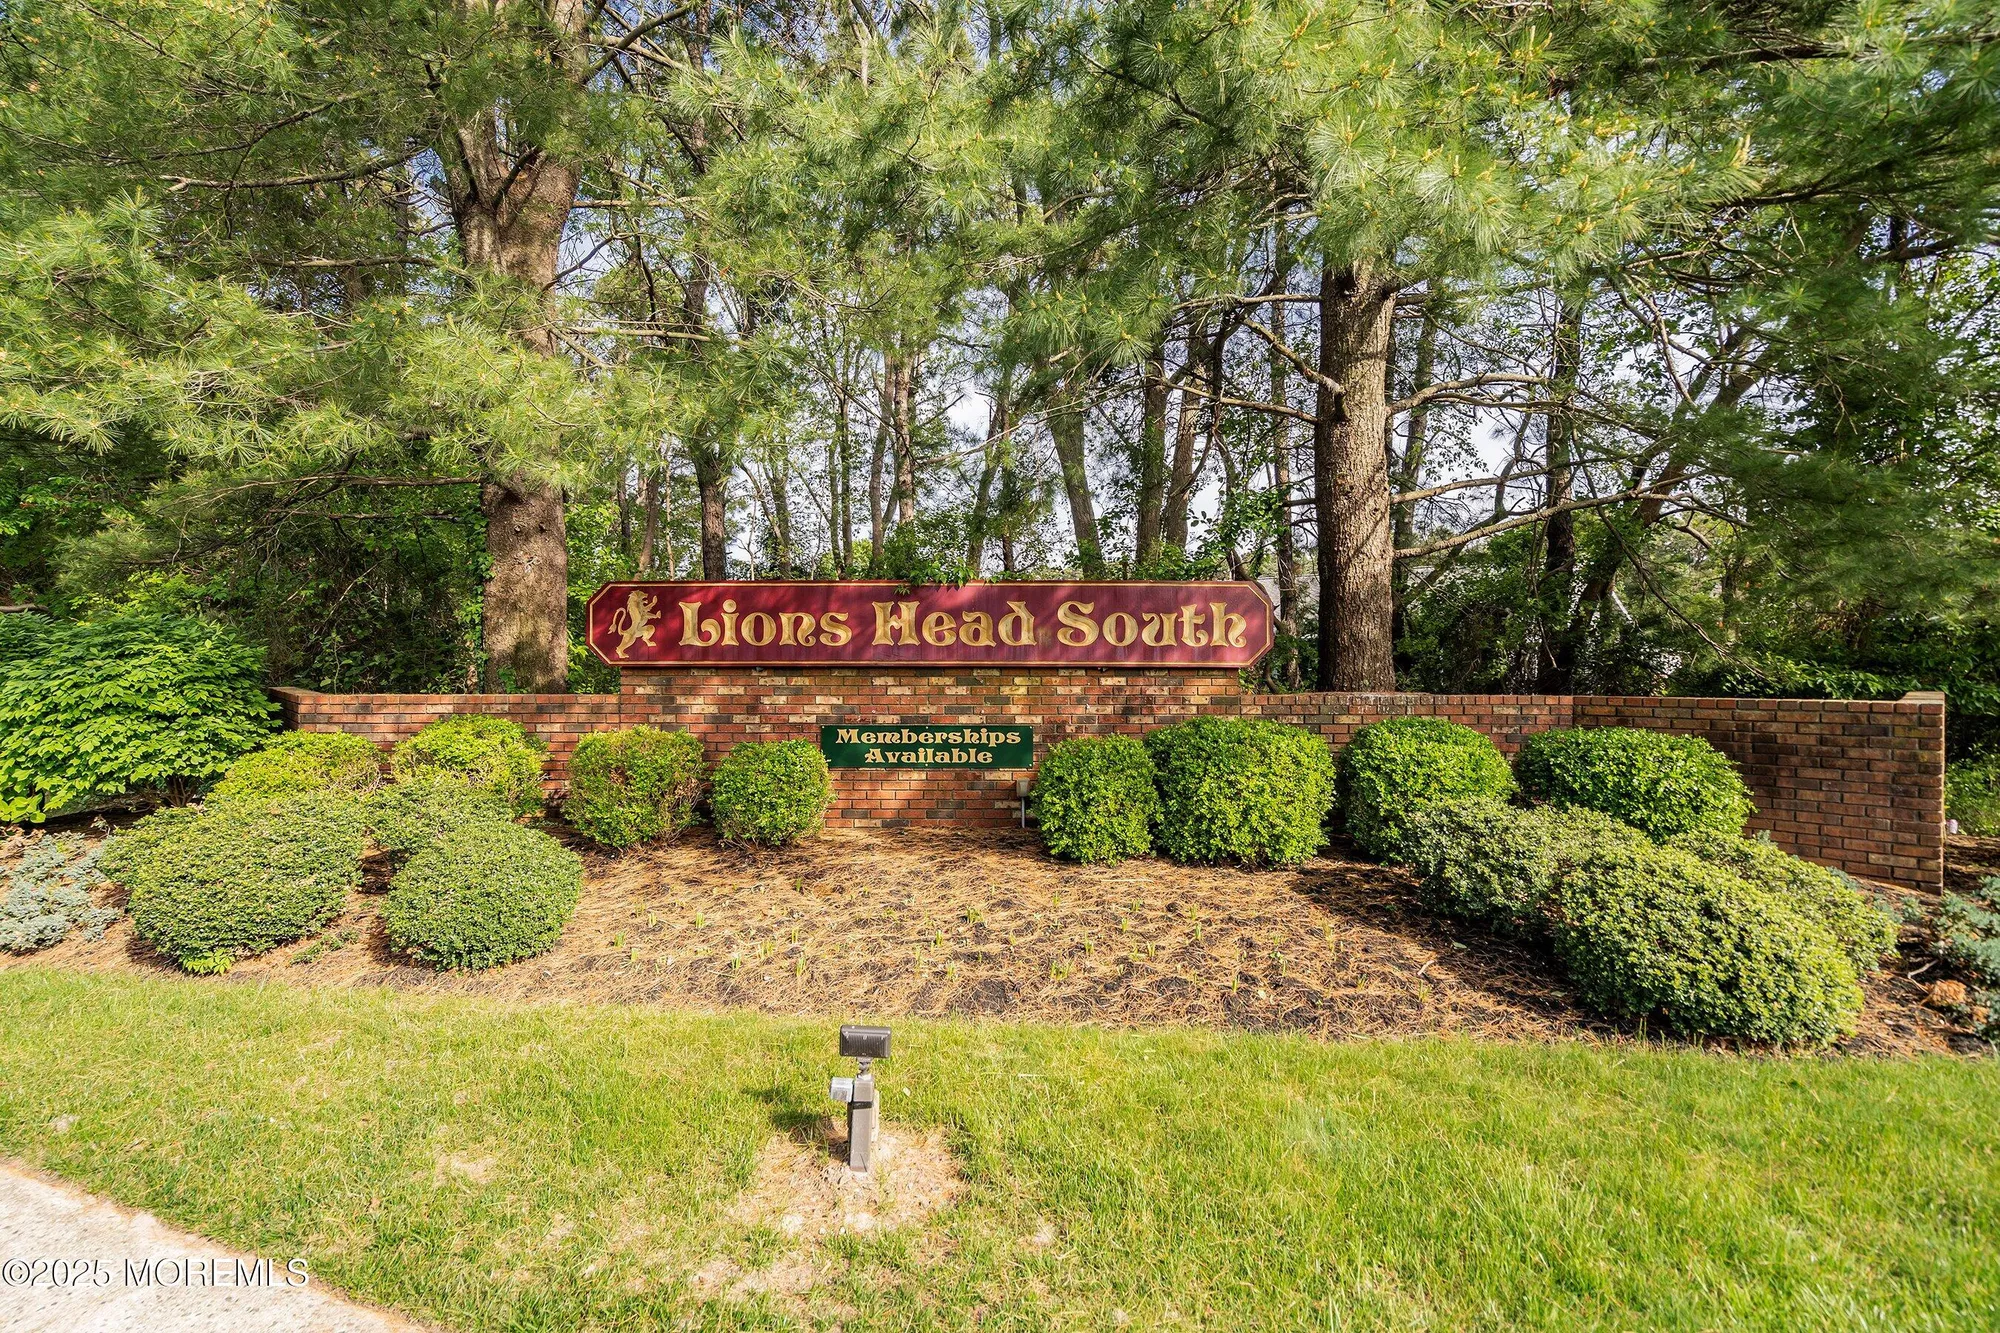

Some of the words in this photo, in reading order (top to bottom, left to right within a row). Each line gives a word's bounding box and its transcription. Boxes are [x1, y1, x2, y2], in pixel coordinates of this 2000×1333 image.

[678, 598, 852, 647] Lions
[871, 600, 1037, 647] Head
[1057, 600, 1247, 647] South
[835, 728, 1021, 747] Memberships
[864, 747, 993, 764] Available
